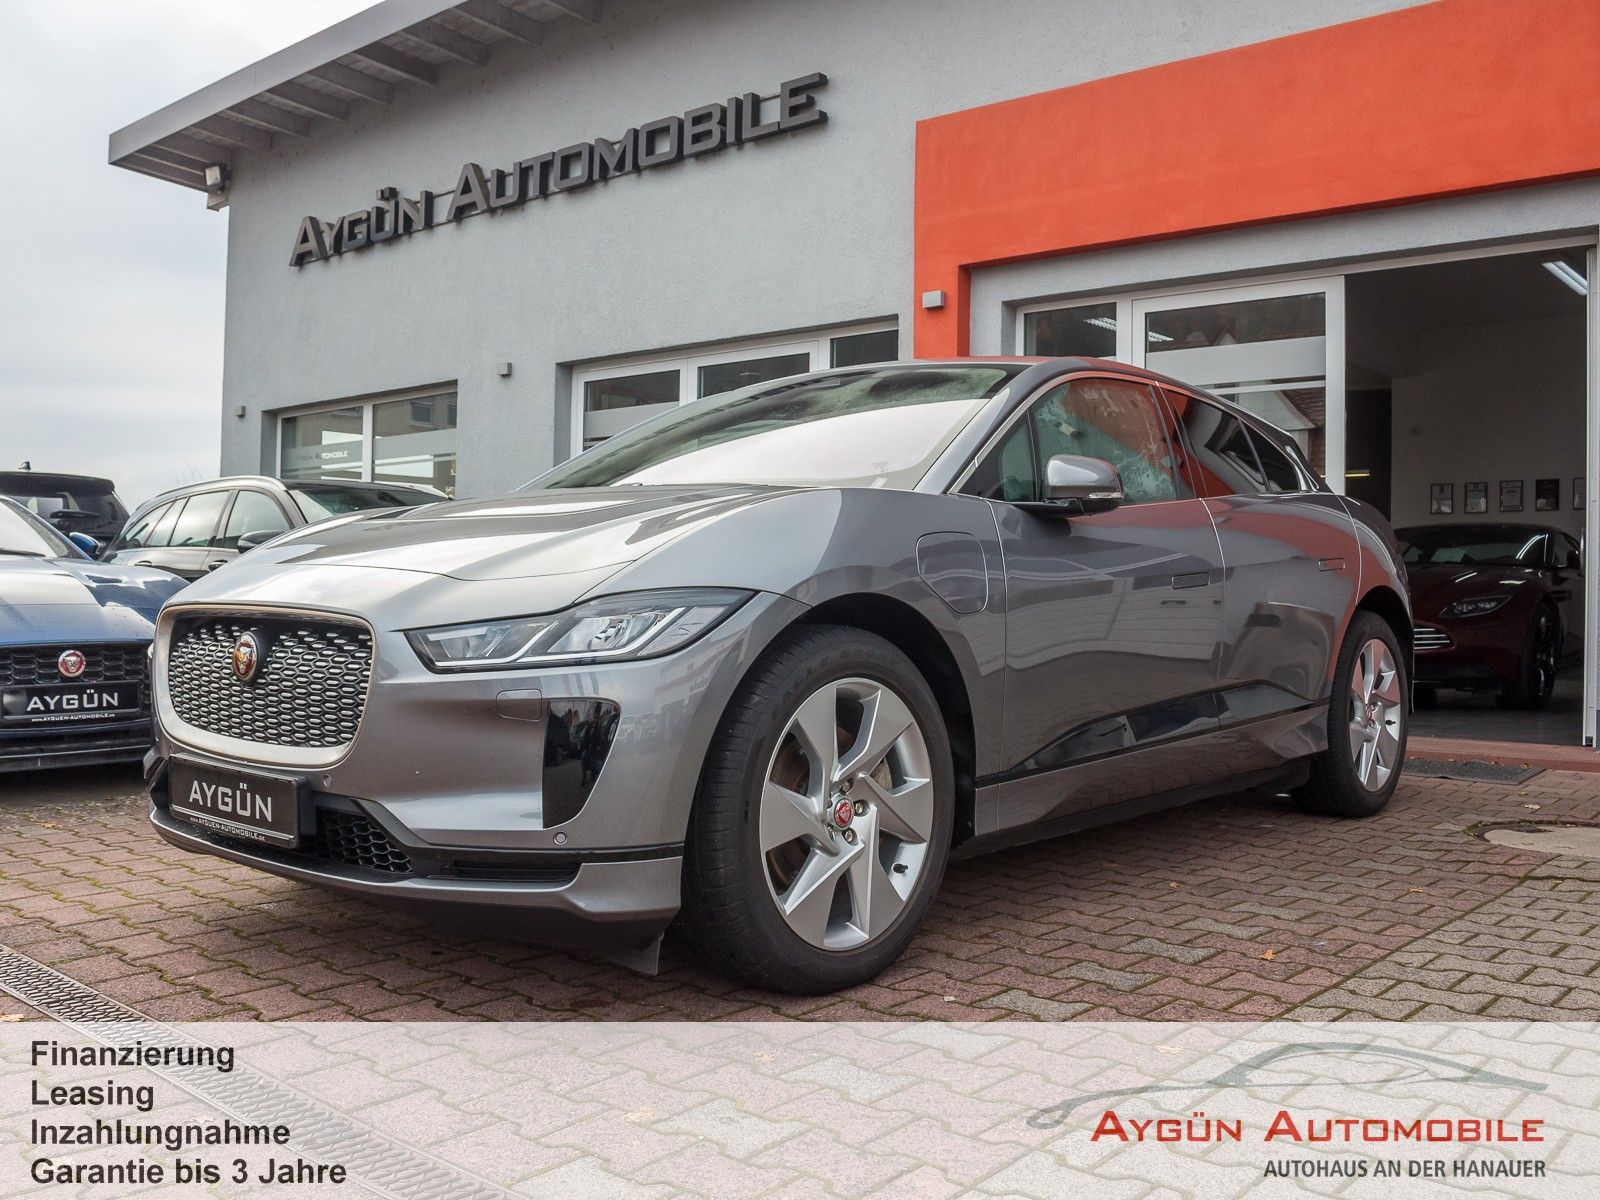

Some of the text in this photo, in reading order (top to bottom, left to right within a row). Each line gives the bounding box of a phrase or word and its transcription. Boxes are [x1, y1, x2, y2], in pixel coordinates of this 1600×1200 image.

[289, 72, 829, 266] AYGÜN AUTOMOBILE
[26, 689, 118, 711] AYGÜN
[189, 780, 272, 822] AYGÜN
